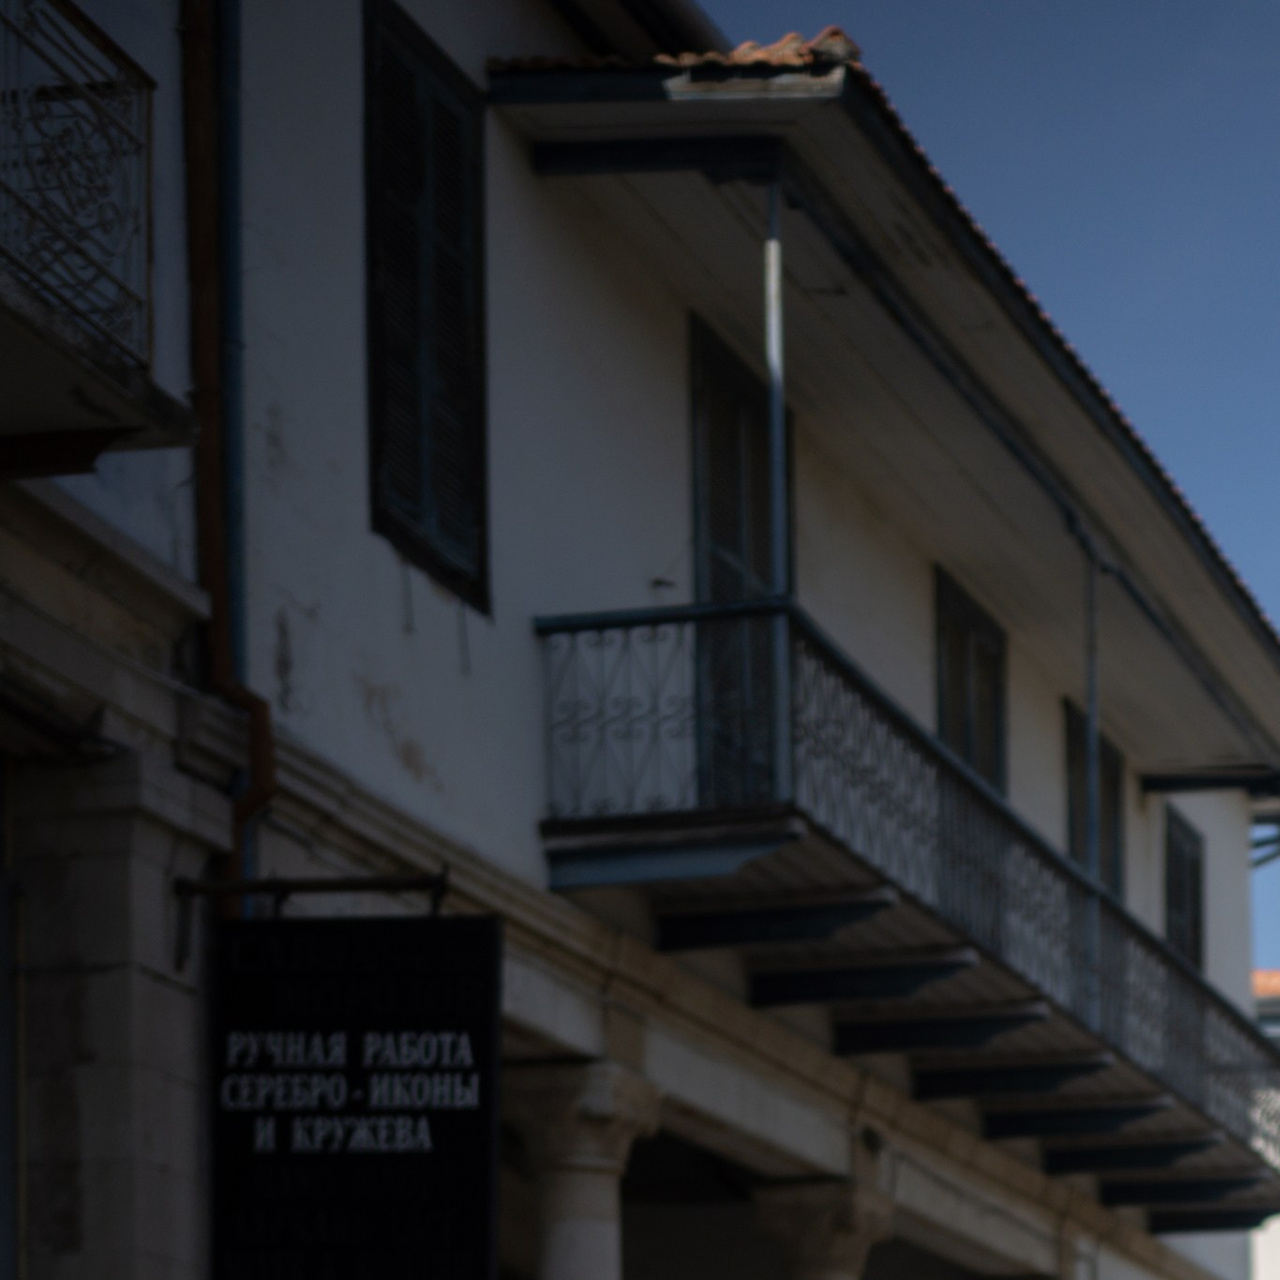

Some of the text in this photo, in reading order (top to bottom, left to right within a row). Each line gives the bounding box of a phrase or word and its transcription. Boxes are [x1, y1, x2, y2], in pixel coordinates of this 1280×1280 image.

[227, 1031, 474, 1067] РУЧНАЯ РАБОТА
[221, 1074, 347, 1109] СЕРЕБРО
[369, 1072, 479, 1108] ИКОНЫ
[255, 1116, 432, 1151] И КРУЖЕВА
